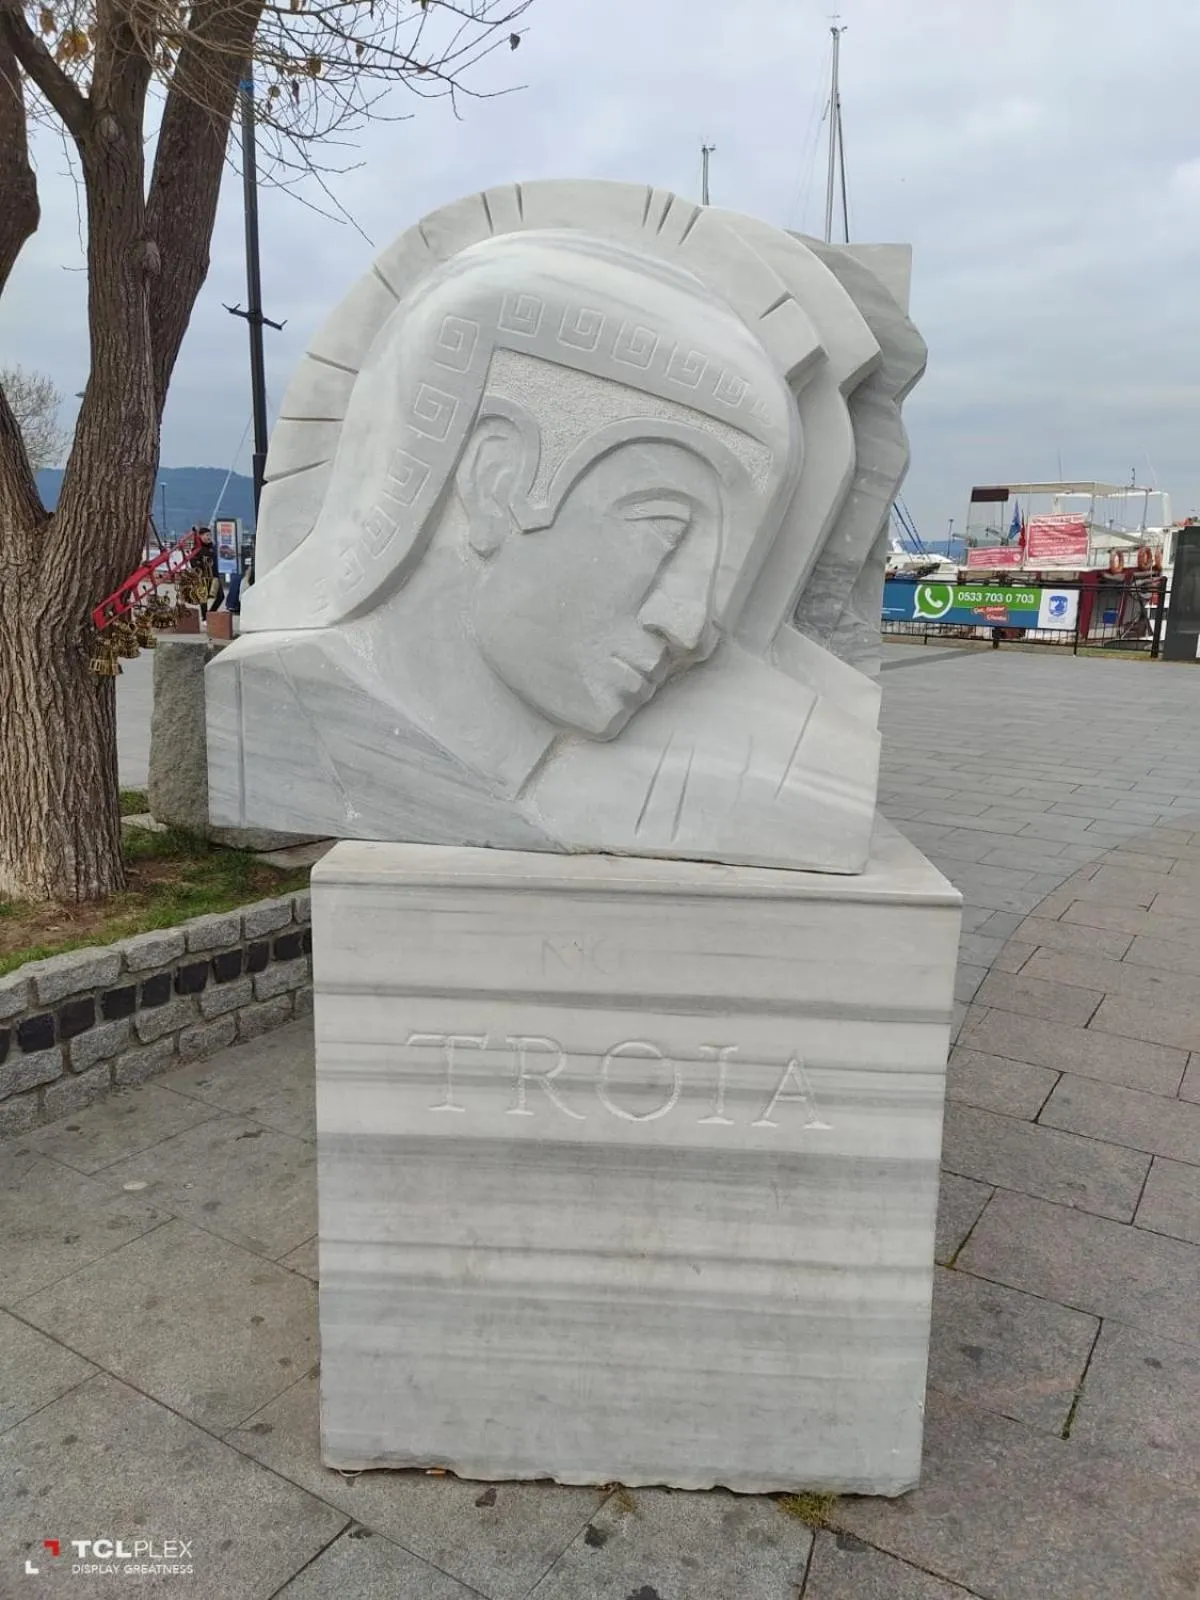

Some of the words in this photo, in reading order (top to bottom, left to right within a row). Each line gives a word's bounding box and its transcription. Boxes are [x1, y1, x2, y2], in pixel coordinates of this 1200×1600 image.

[958, 591, 982, 602] 0533
[985, 593, 1003, 602] 703
[1006, 594, 1012, 602] 0
[1016, 594, 1034, 604] 703
[405, 1031, 833, 1131] TROIA
